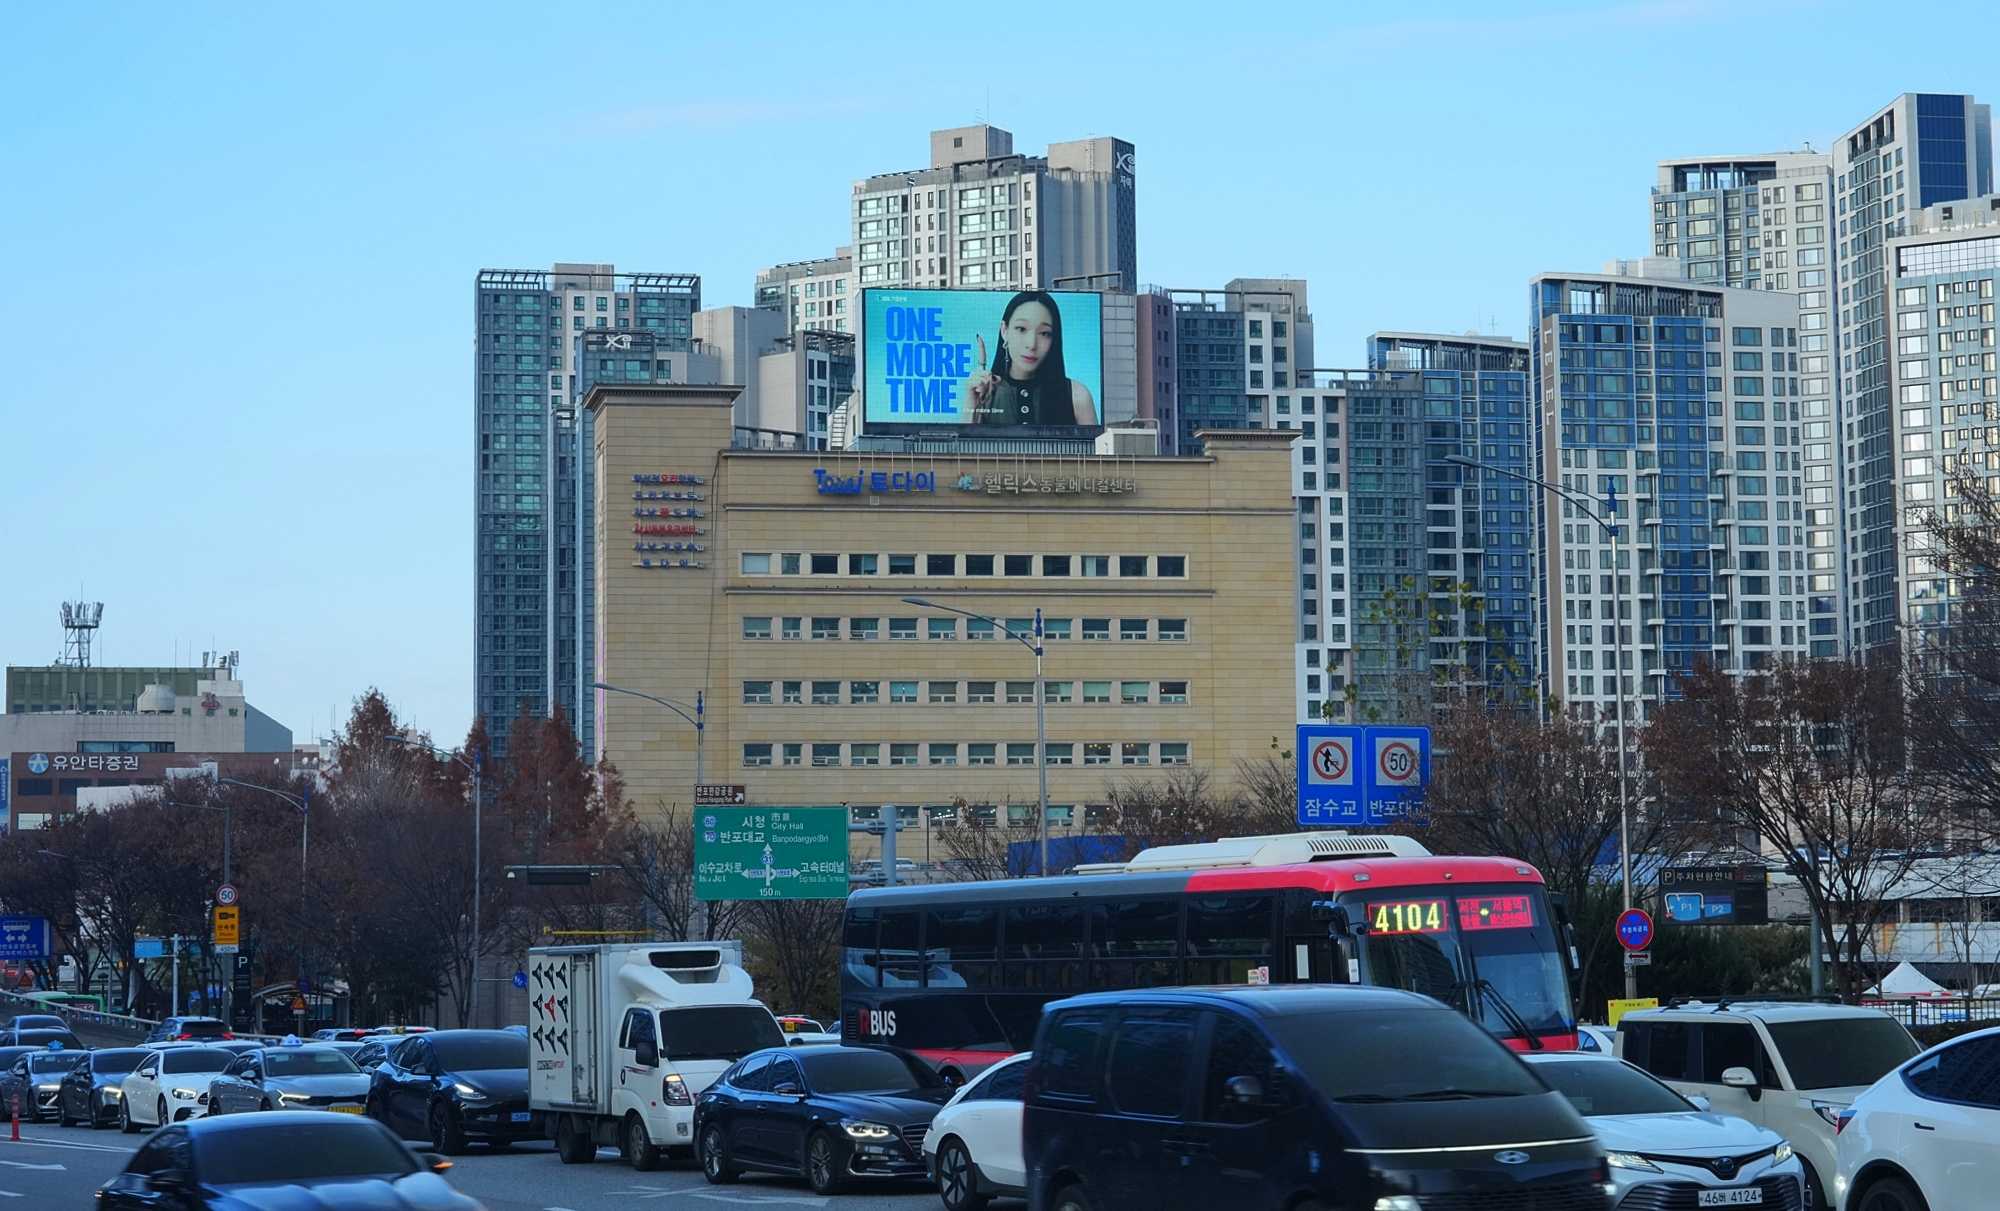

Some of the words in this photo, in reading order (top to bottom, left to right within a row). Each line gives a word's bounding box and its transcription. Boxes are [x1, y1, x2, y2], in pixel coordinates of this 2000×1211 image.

[885, 306, 943, 342] ONE
[886, 342, 972, 378] MORE
[885, 378, 958, 414] TIME
[870, 471, 935, 492] 토다이
[52, 754, 139, 771] 유안타증권
[1390, 753, 1408, 772] 50
[1305, 799, 1358, 817] 잠수교
[742, 815, 766, 829] 시청
[771, 822, 787, 831] City
[720, 831, 765, 844] 반포대교
[698, 862, 742, 874] 이수교차로
[801, 862, 845, 874] 고속터미널
[221, 890, 233, 900] 50
[760, 888, 773, 897] 150
[1681, 903, 1693, 911] P1
[1711, 905, 1724, 913] P2
[1375, 903, 1440, 933] 4104
[238, 956, 248, 968] P
[1730, 1190, 1757, 1202] 4124
